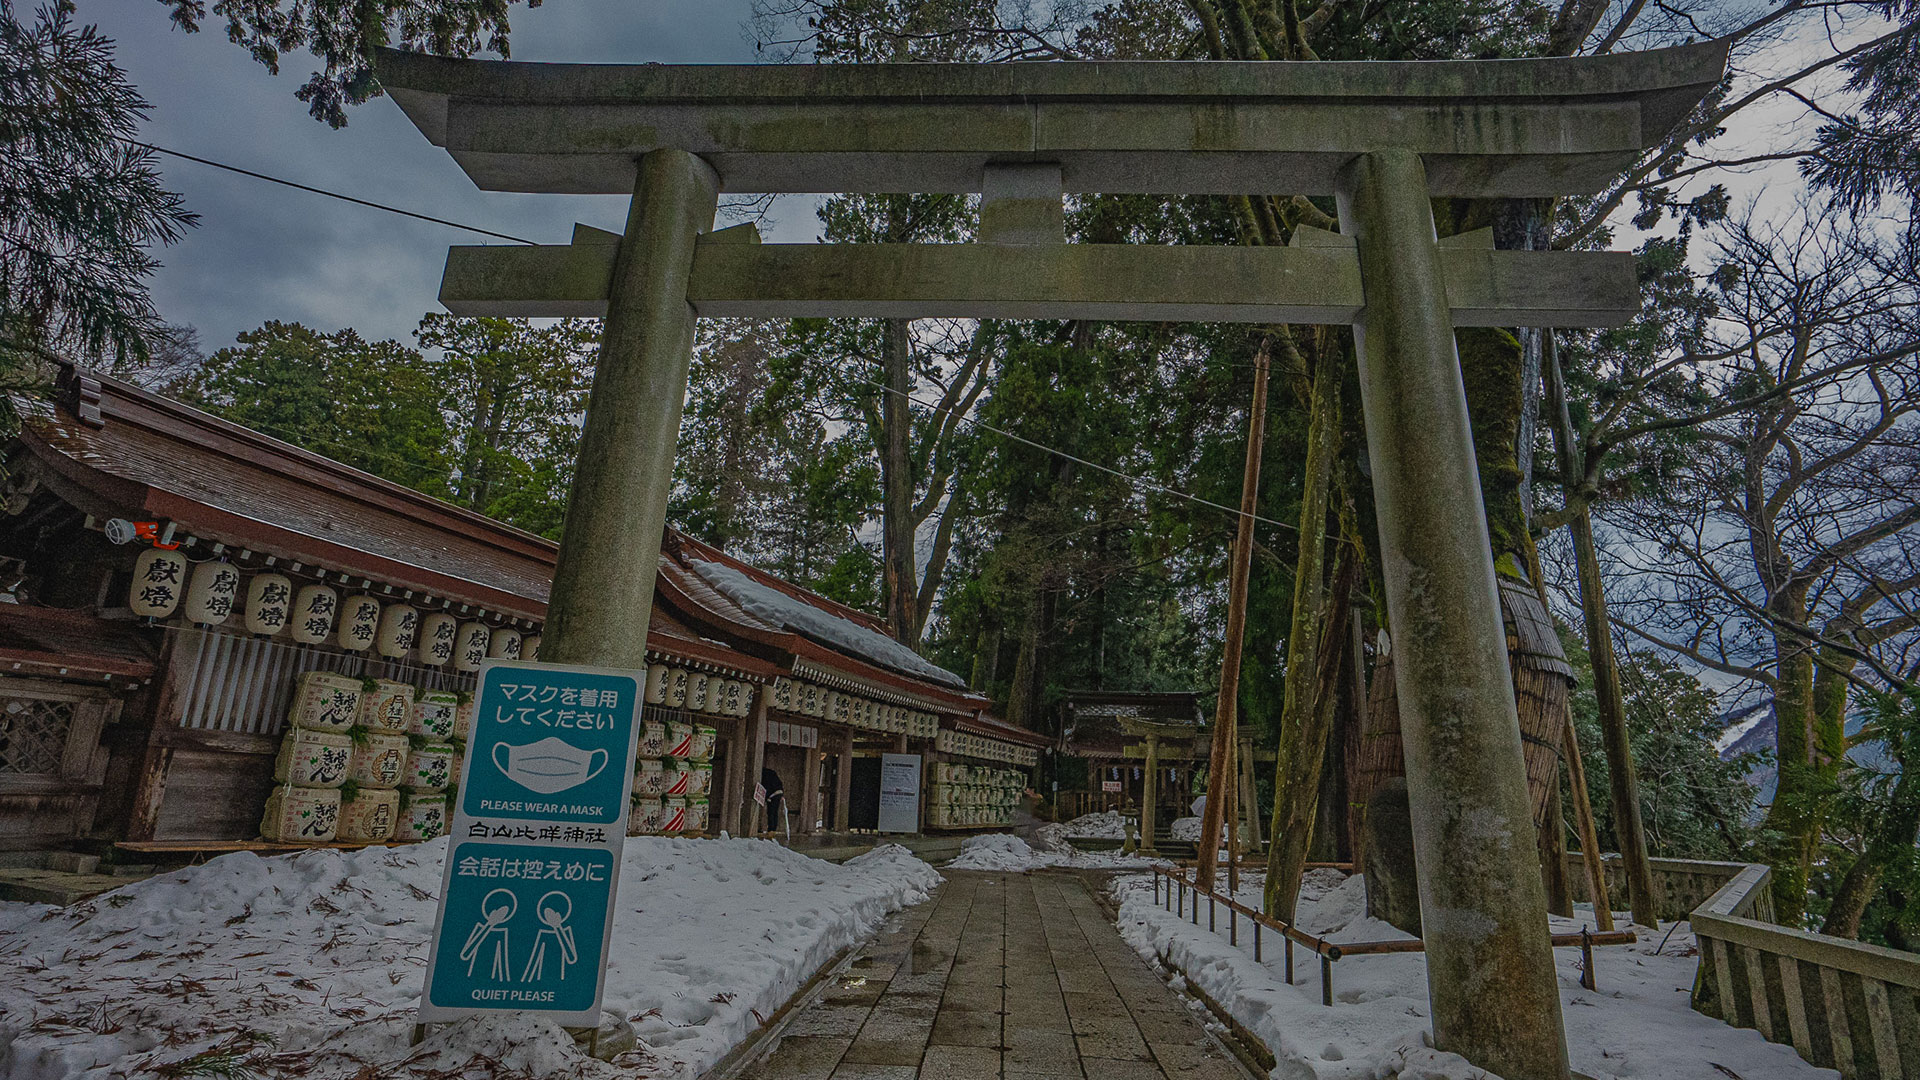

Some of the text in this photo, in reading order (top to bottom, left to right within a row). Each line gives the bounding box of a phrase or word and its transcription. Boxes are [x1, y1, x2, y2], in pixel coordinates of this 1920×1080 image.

[500, 683, 619, 709] マスクを着用
[496, 706, 614, 730] してください
[480, 799, 603, 816] PLEASE WEAR A MASK
[469, 821, 607, 843] 白山比咩神社
[457, 856, 605, 881] 会話は控えめに
[471, 989, 555, 1002] QUIET PLEASE
